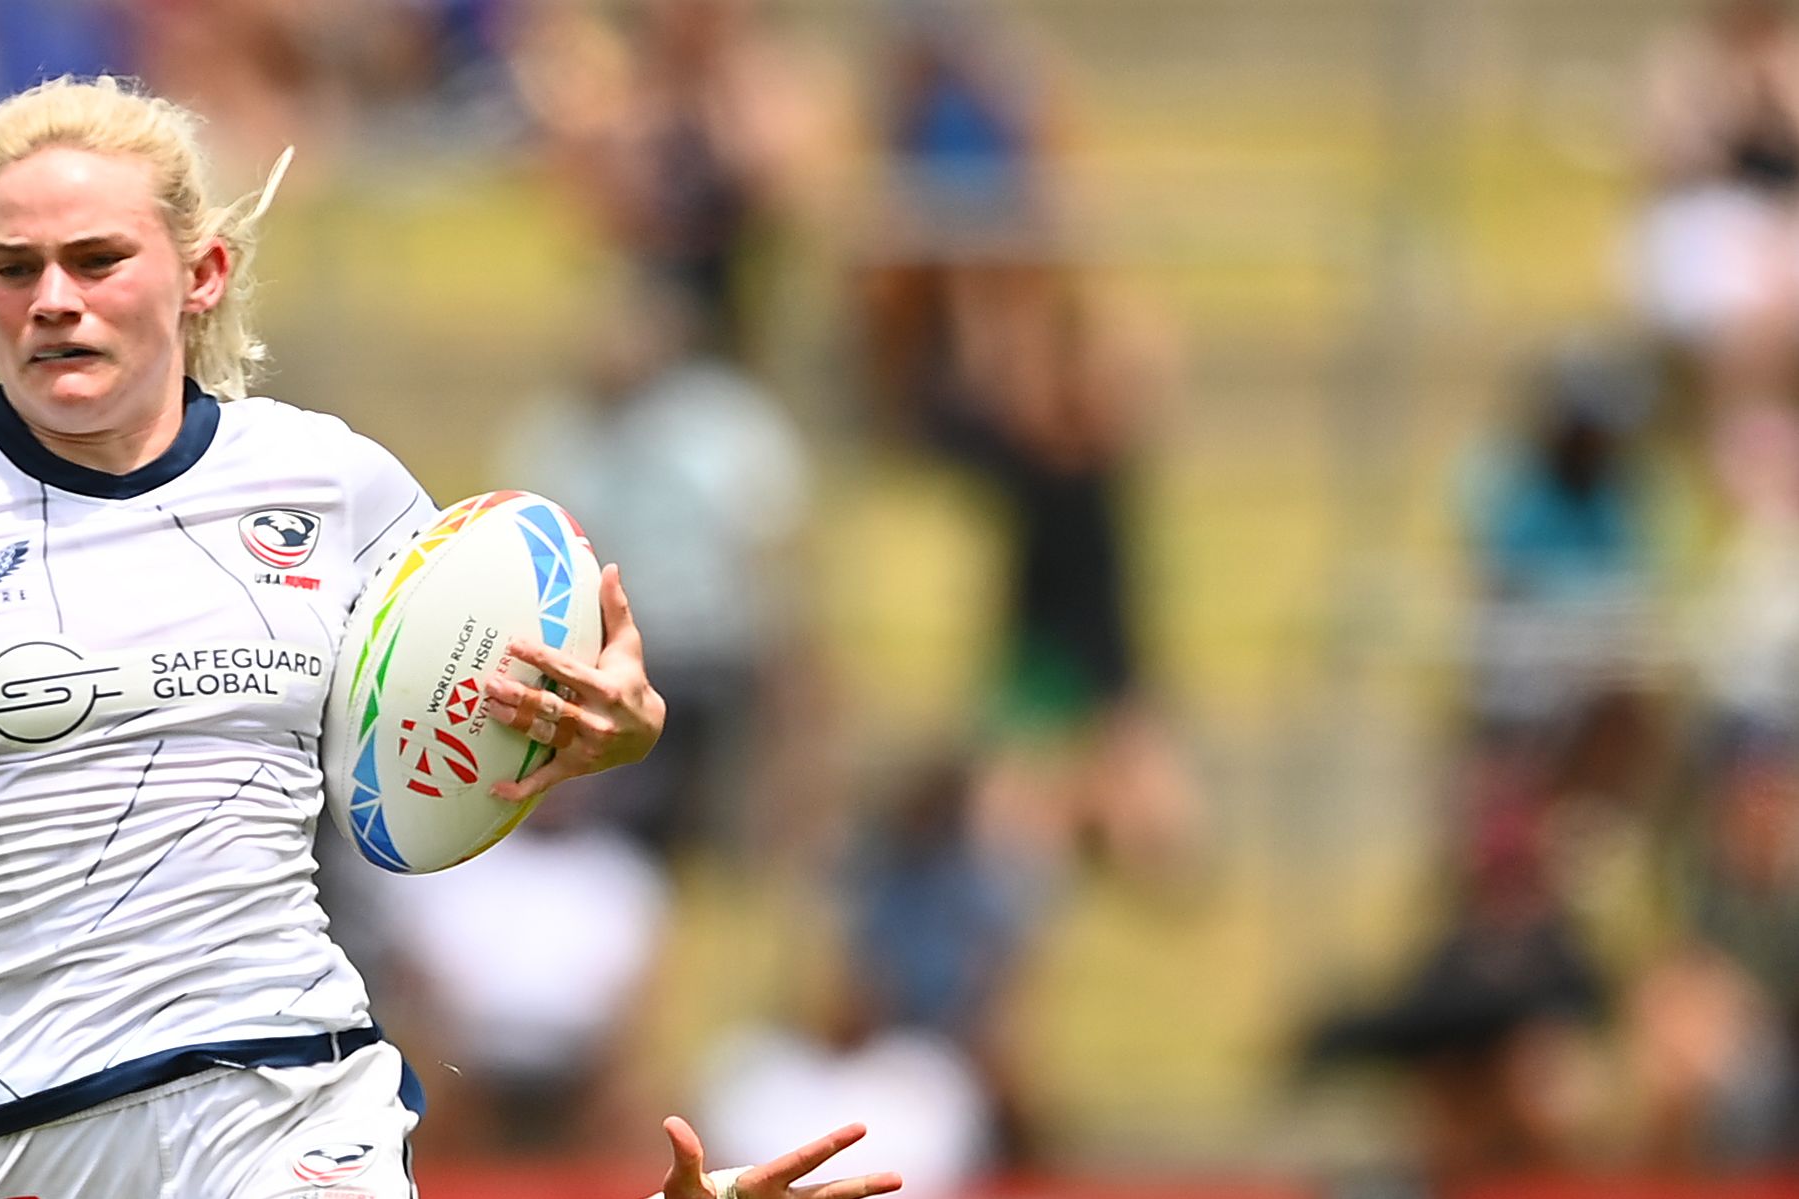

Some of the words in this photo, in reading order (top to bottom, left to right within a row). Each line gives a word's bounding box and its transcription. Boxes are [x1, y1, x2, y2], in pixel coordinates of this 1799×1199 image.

[151, 648, 322, 677] SAFEGUARD
[427, 662, 457, 715] WORLD
[450, 615, 478, 662] RUGBY
[470, 627, 499, 671] HSBC
[153, 673, 279, 699] GLOBAL
